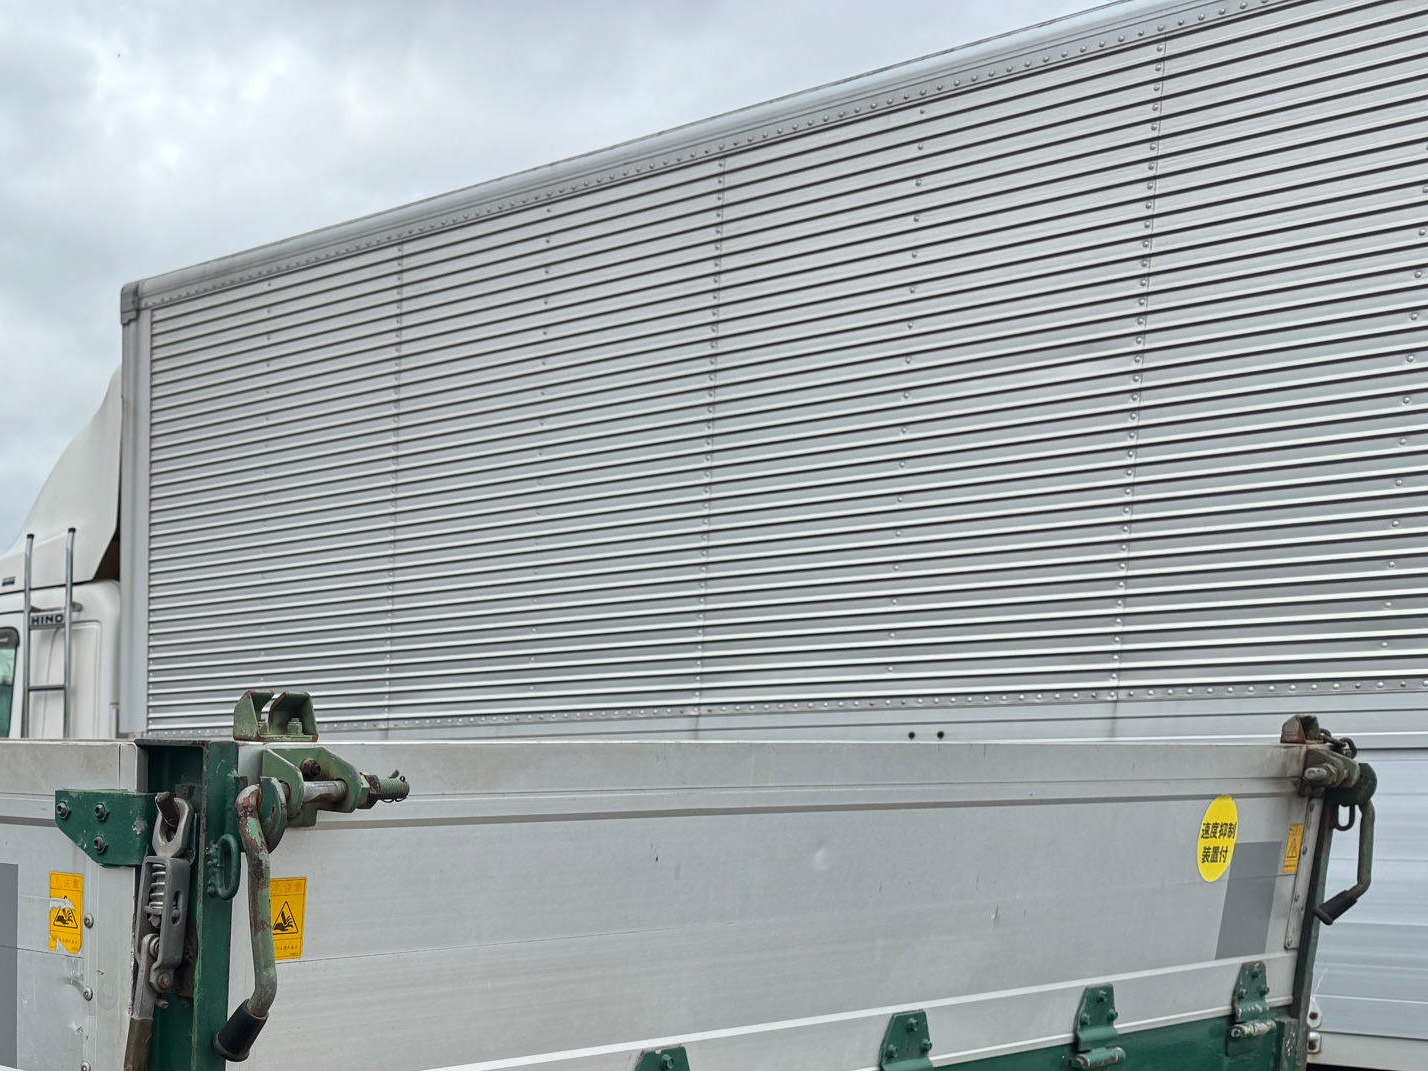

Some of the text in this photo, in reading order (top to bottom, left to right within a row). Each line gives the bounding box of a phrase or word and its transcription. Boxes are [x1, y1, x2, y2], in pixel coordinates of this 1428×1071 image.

[32, 614, 63, 625] HINO
[1201, 822, 1237, 839] 速度抑制
[1201, 846, 1228, 863] 装置付
